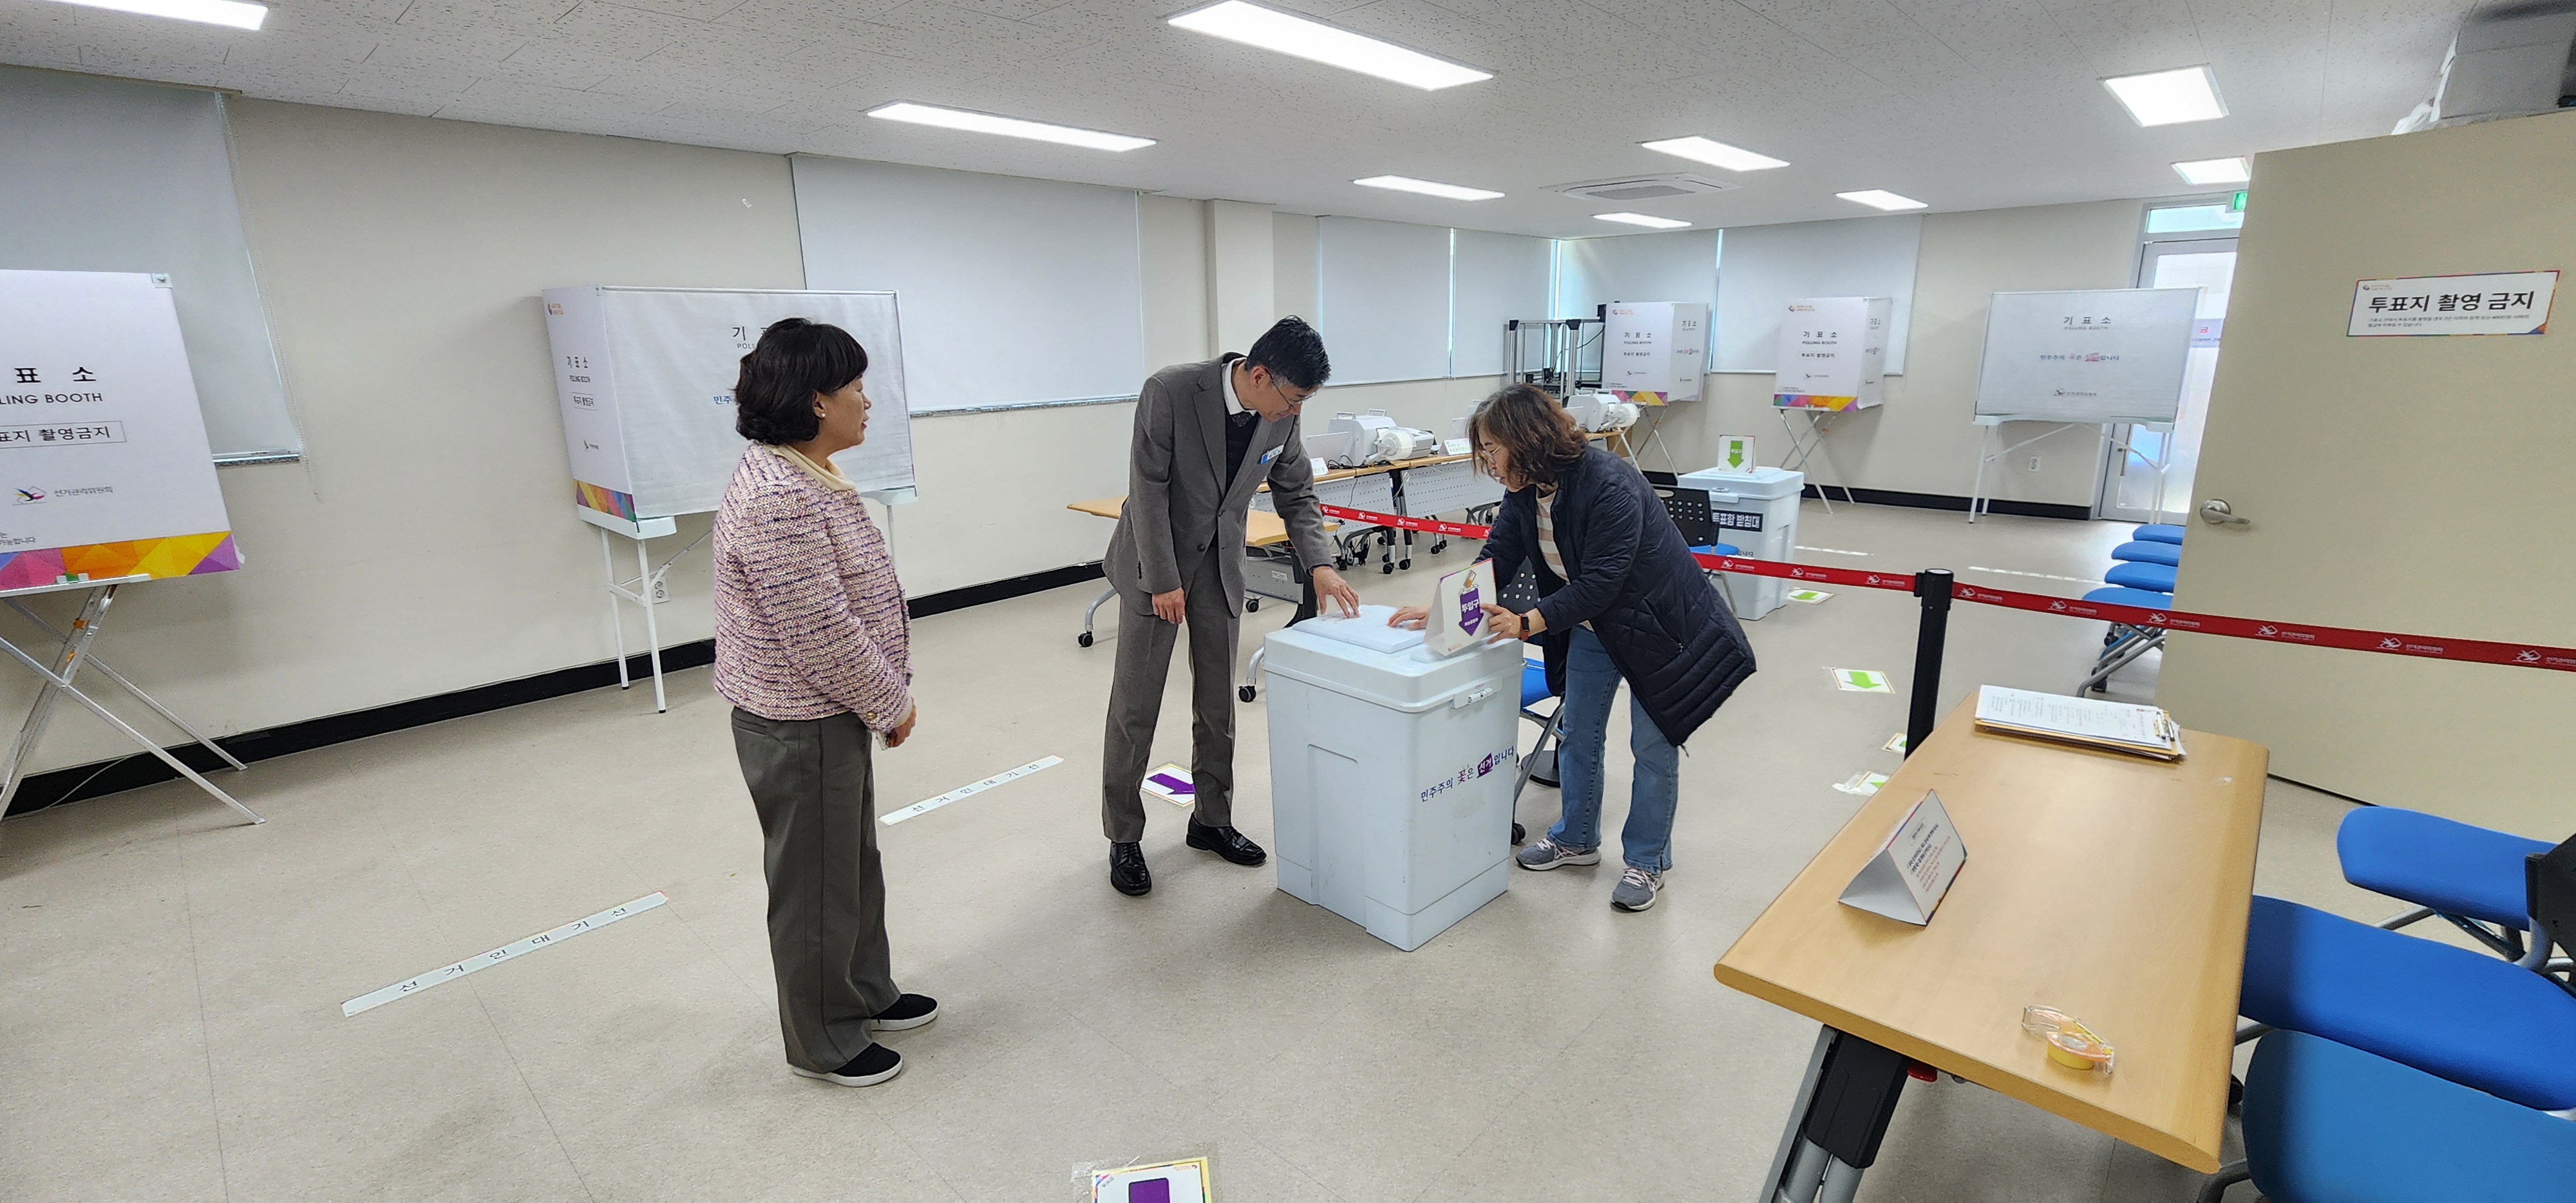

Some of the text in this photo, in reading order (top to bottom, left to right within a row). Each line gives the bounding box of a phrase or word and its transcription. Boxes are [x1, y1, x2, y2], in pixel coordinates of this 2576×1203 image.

[2369, 291, 2535, 313] 투표지 촬영 금지
[14, 366, 97, 383] 표 소
[0, 393, 103, 404] LING BOOTH
[713, 395, 732, 404] 민주
[0, 426, 111, 442] 표지 촬영금지
[1736, 515, 1760, 529] 받침대
[1461, 598, 1480, 614] 투입구
[1421, 745, 1514, 802] 민주주의 꽃은 선거입니다
